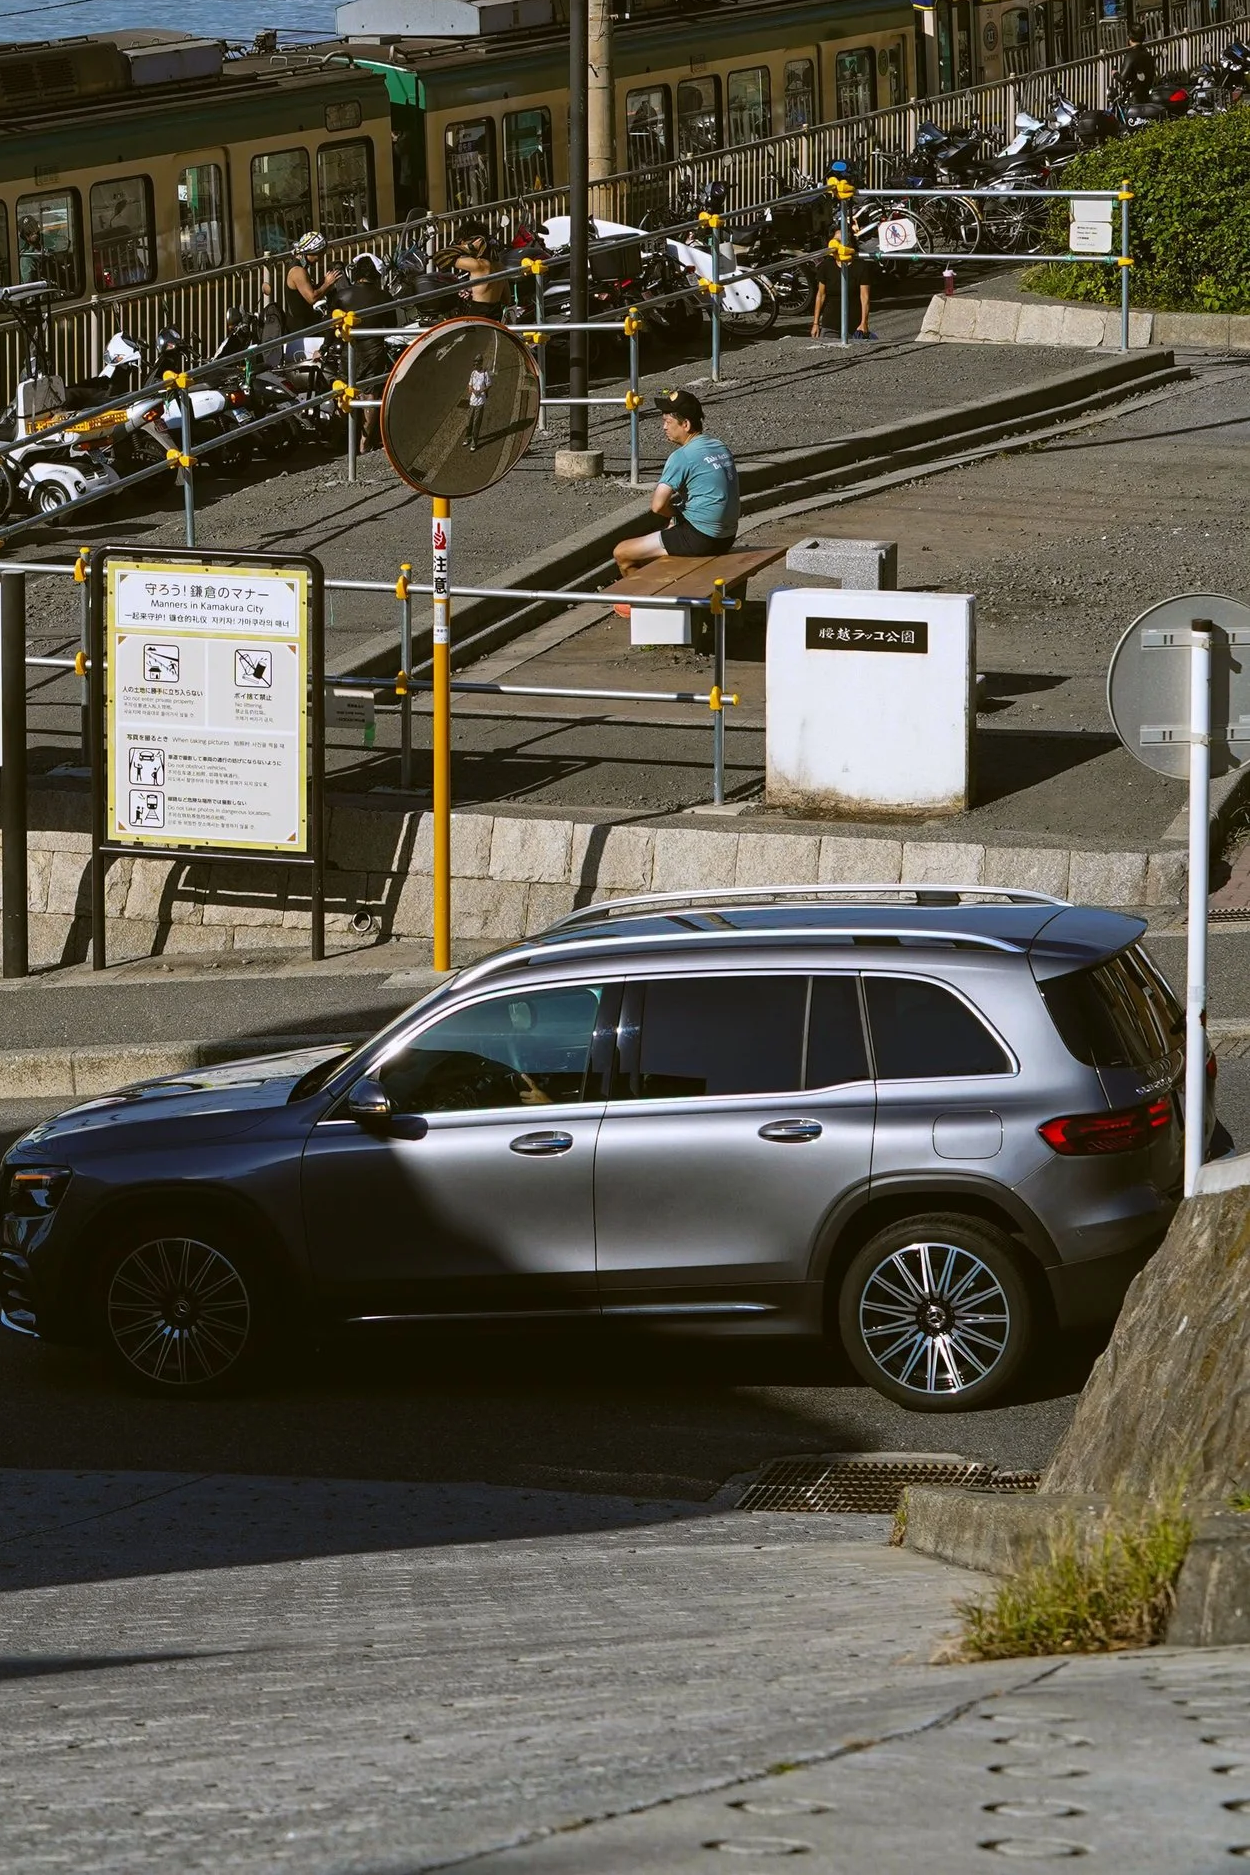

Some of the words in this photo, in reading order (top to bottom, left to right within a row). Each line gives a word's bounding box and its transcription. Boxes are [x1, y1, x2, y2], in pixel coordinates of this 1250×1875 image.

[433, 556, 447, 594] 注意
[151, 600, 188, 609] Manners
[190, 602, 198, 610] in
[201, 602, 244, 612] Kamakura
[247, 604, 264, 615] City
[818, 627, 915, 644] 腰越ラッコ公園
[123, 686, 203, 697] 人の土地に勝手に立ち入らない
